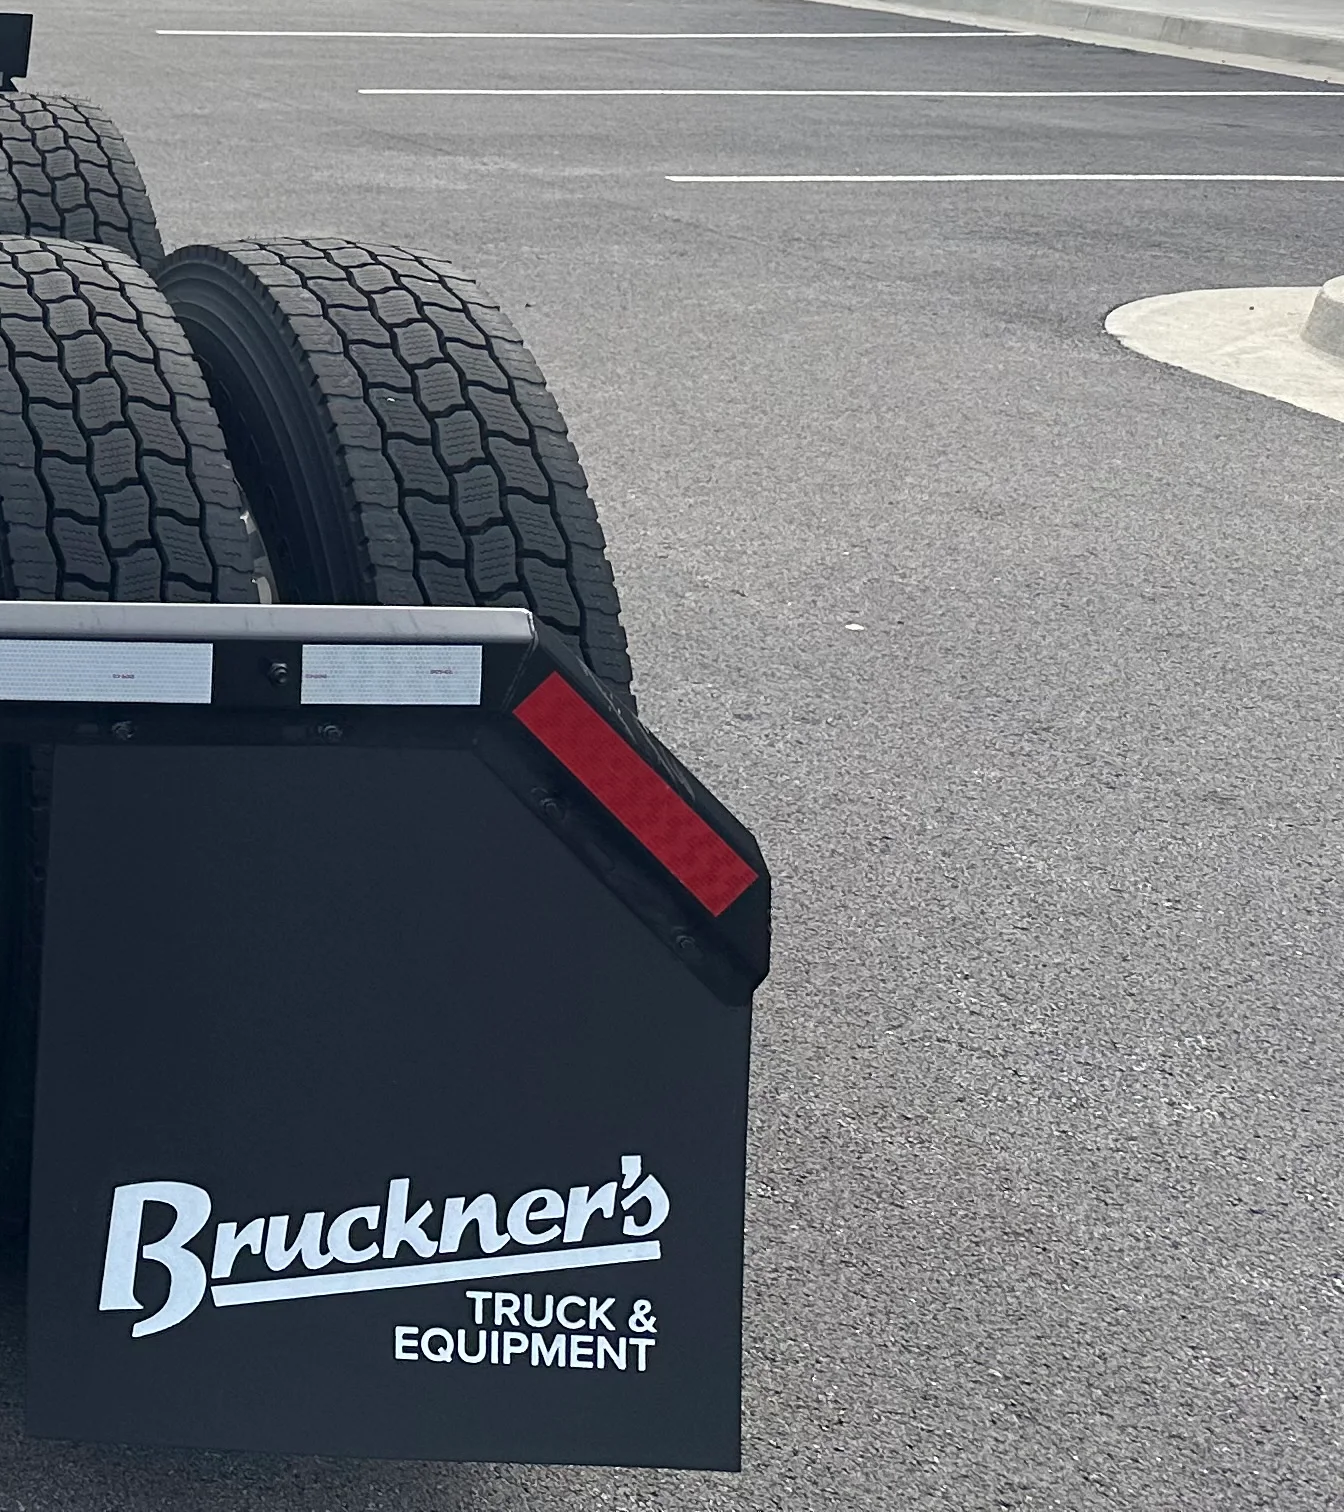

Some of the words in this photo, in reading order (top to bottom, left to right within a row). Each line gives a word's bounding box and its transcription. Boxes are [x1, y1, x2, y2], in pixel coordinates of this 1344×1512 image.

[98, 1154, 670, 1339] Bruckner's
[465, 1290, 616, 1331] TRUCK
[628, 1299, 658, 1334] &
[394, 1325, 656, 1372] EQUIPMENT
